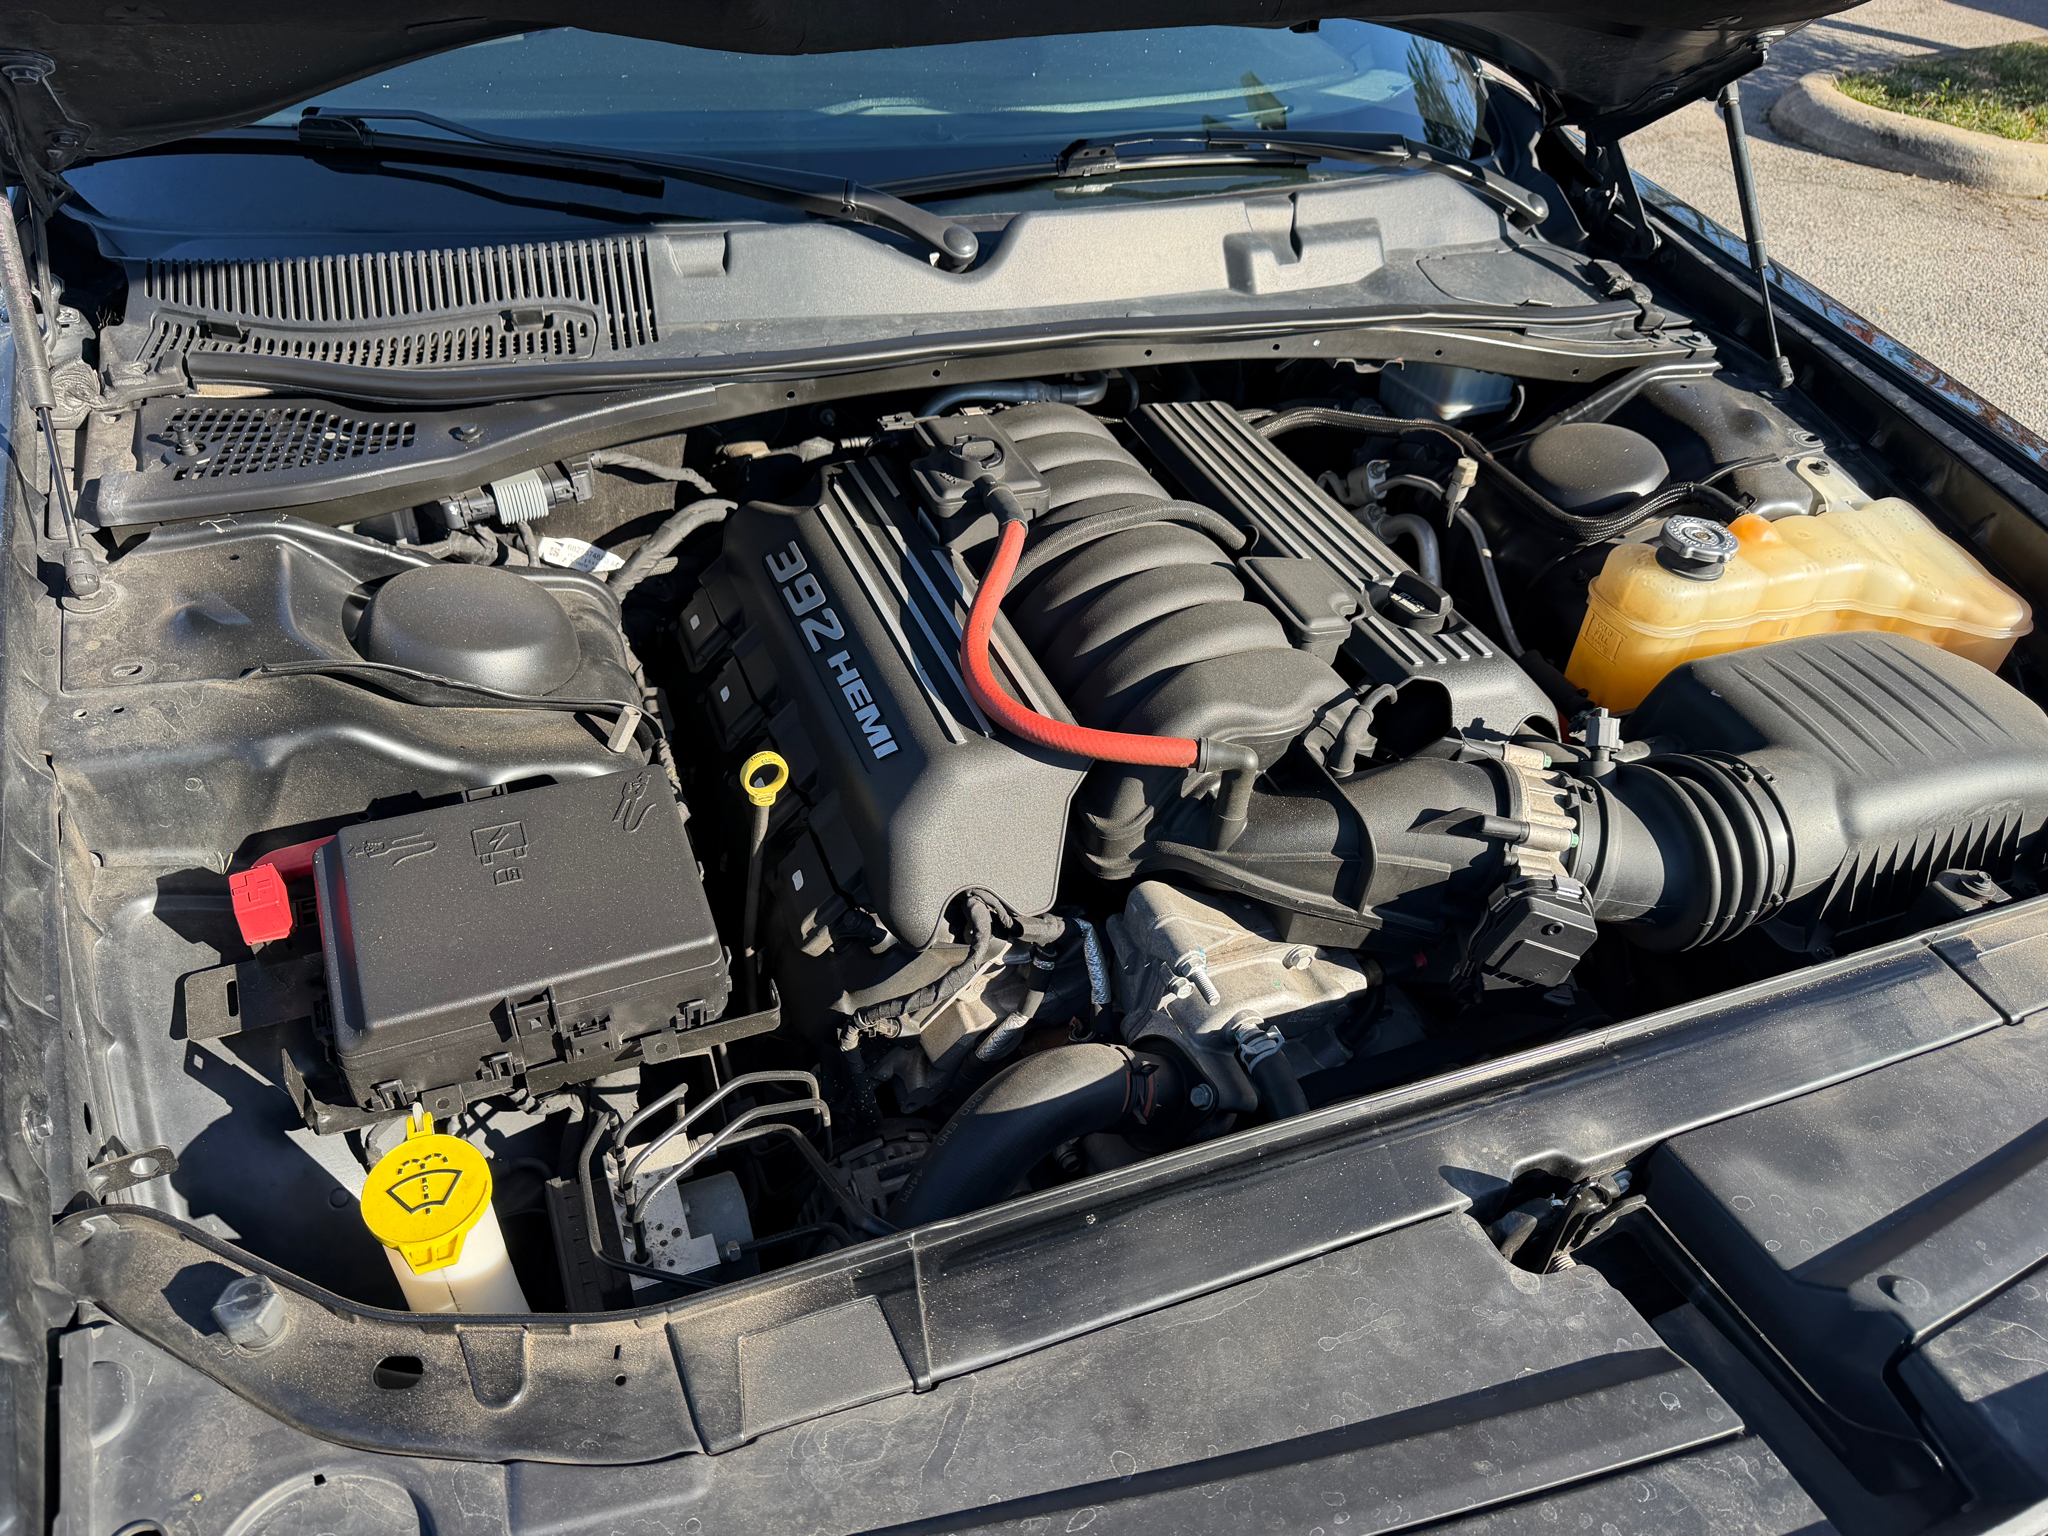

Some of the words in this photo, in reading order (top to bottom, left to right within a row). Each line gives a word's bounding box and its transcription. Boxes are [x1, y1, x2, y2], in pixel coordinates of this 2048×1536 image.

[1594, 629, 1609, 646] FILL
[1597, 622, 1613, 637] COLD
[765, 540, 845, 653] 392
[827, 650, 899, 760] HEMI
[961, 1093, 984, 1116] RAD
[937, 1121, 958, 1147] END
[900, 1169, 923, 1203] 44MM
